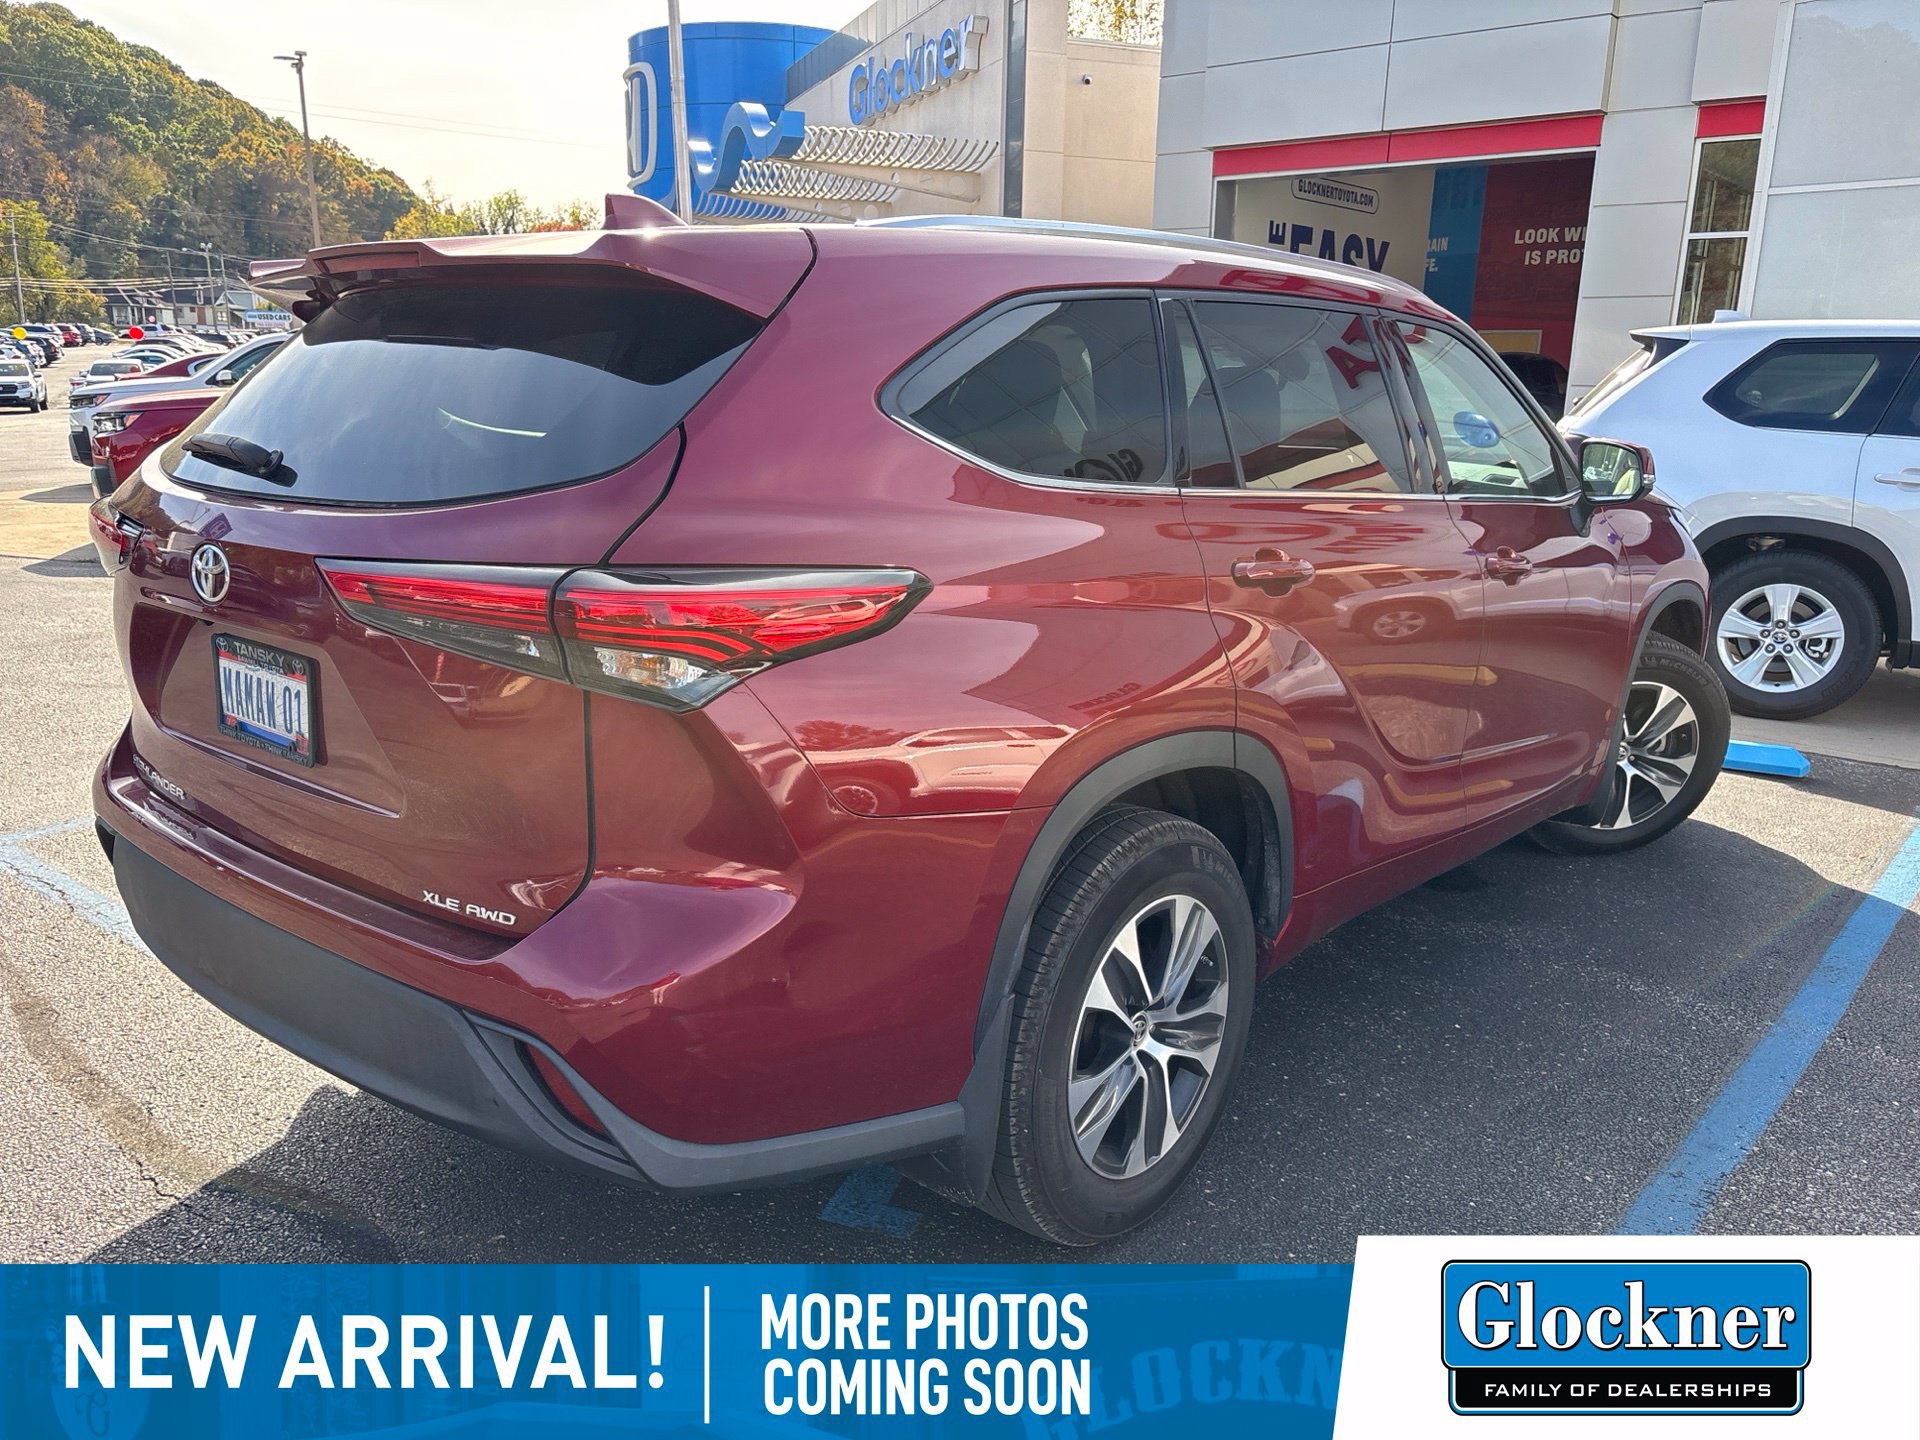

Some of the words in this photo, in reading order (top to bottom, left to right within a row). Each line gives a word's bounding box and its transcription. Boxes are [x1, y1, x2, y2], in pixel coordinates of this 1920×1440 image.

[849, 14, 984, 126] Glockner
[1298, 179, 1374, 208] GLOCKNERTOYOTA.COM
[1514, 227, 1559, 245] LOOK
[1524, 250, 1541, 266] IS
[1545, 249, 1584, 265] PRO
[257, 313, 274, 321] USED
[233, 641, 285, 668] TANSKY
[223, 666, 277, 730] MAMAW
[283, 685, 302, 736] 01
[219, 726, 238, 740] THINK
[238, 732, 261, 749] TOYOTA
[264, 742, 284, 757] THINK
[283, 750, 310, 767] TANSKY
[422, 889, 461, 912] XLE
[465, 903, 517, 926] AWD
